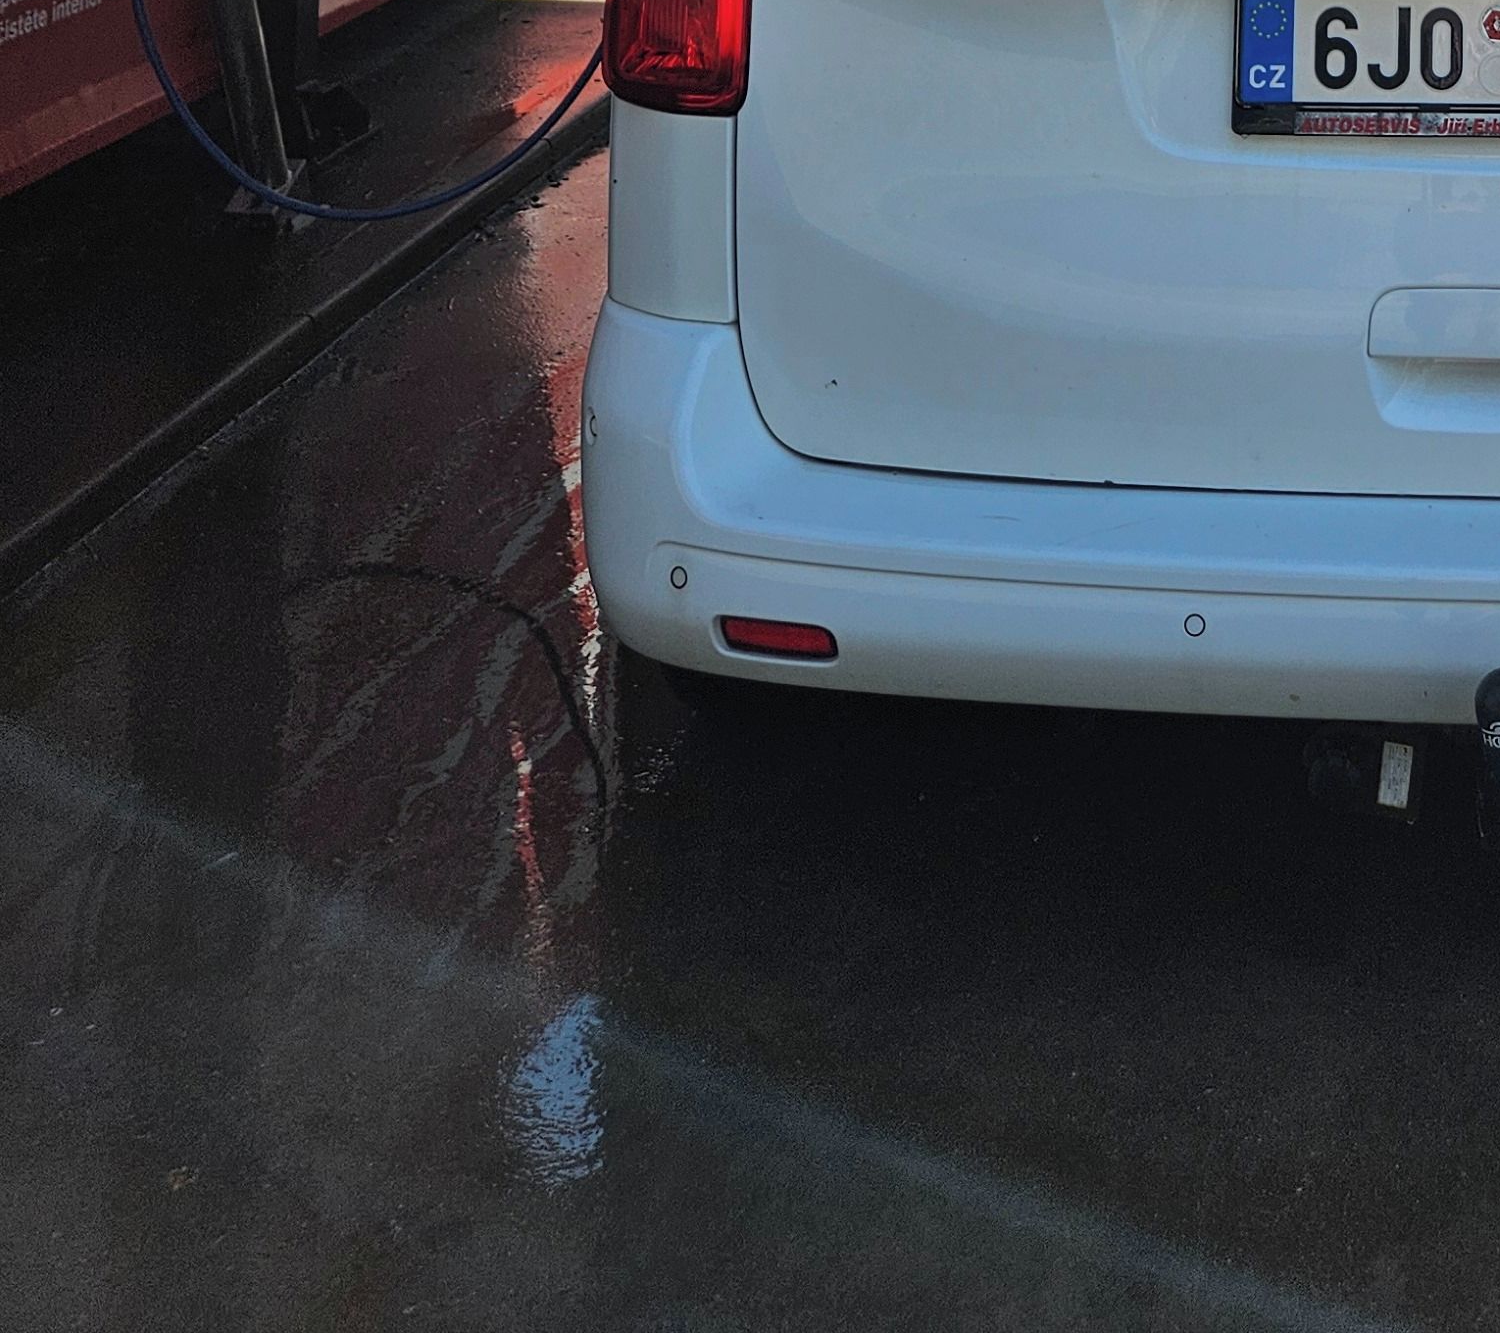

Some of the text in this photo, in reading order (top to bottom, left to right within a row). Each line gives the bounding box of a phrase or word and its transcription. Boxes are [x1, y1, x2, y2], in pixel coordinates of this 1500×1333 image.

[1248, 63, 1287, 90] CZ
[1302, 116, 1422, 134] AUTOSERVIS
[1436, 116, 1467, 136] Jiří
